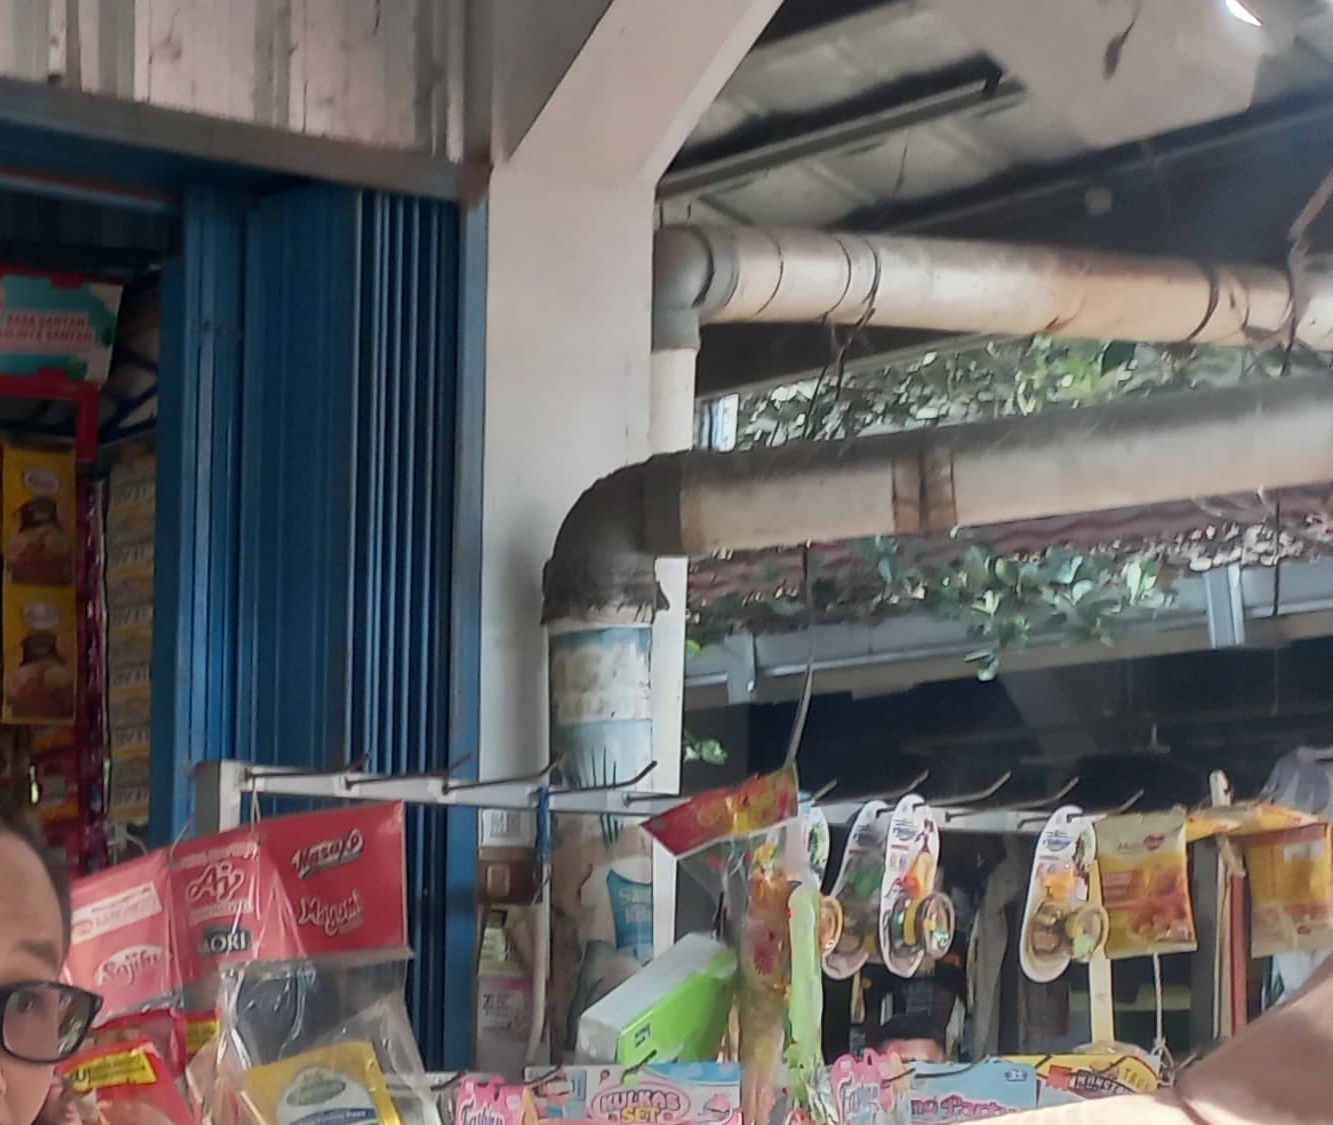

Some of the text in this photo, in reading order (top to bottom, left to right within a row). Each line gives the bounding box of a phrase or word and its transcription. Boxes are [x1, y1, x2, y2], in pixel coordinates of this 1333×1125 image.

[202, 927, 249, 957] AORI
[599, 1089, 681, 1112] KULKAS
[620, 1107, 662, 1123] SET
